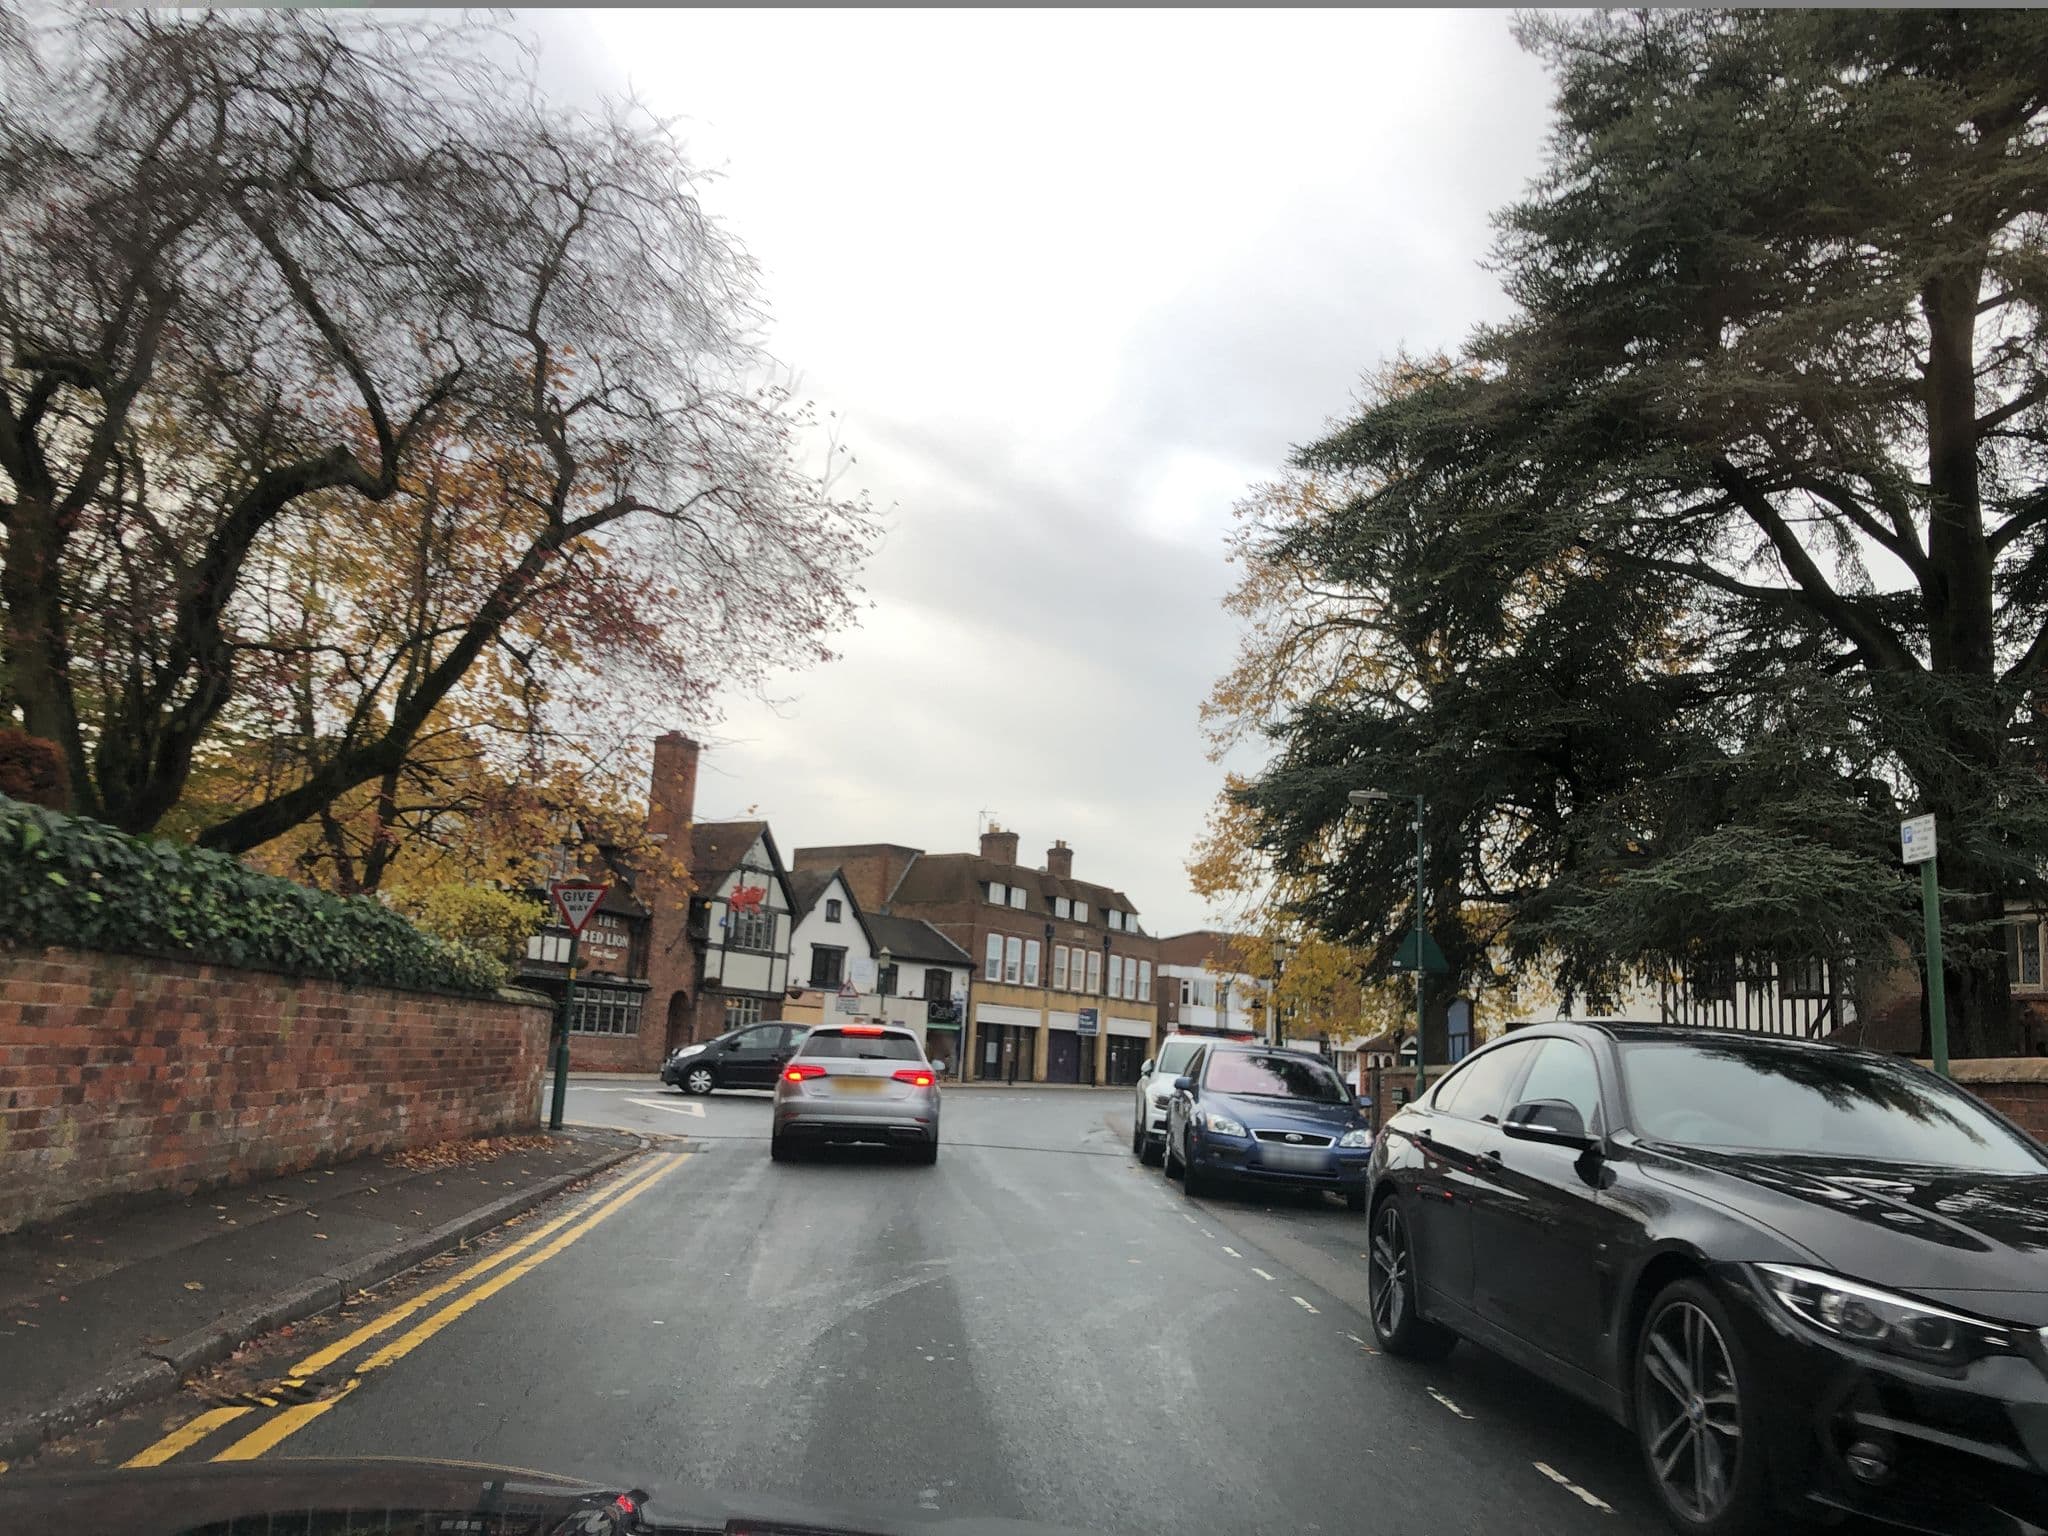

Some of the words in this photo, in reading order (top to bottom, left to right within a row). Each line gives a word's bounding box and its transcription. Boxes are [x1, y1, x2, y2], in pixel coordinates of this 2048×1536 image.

[562, 891, 595, 902] GIVE
[598, 914, 618, 928] THE
[580, 929, 604, 944] RED
[607, 933, 628, 948] LION
